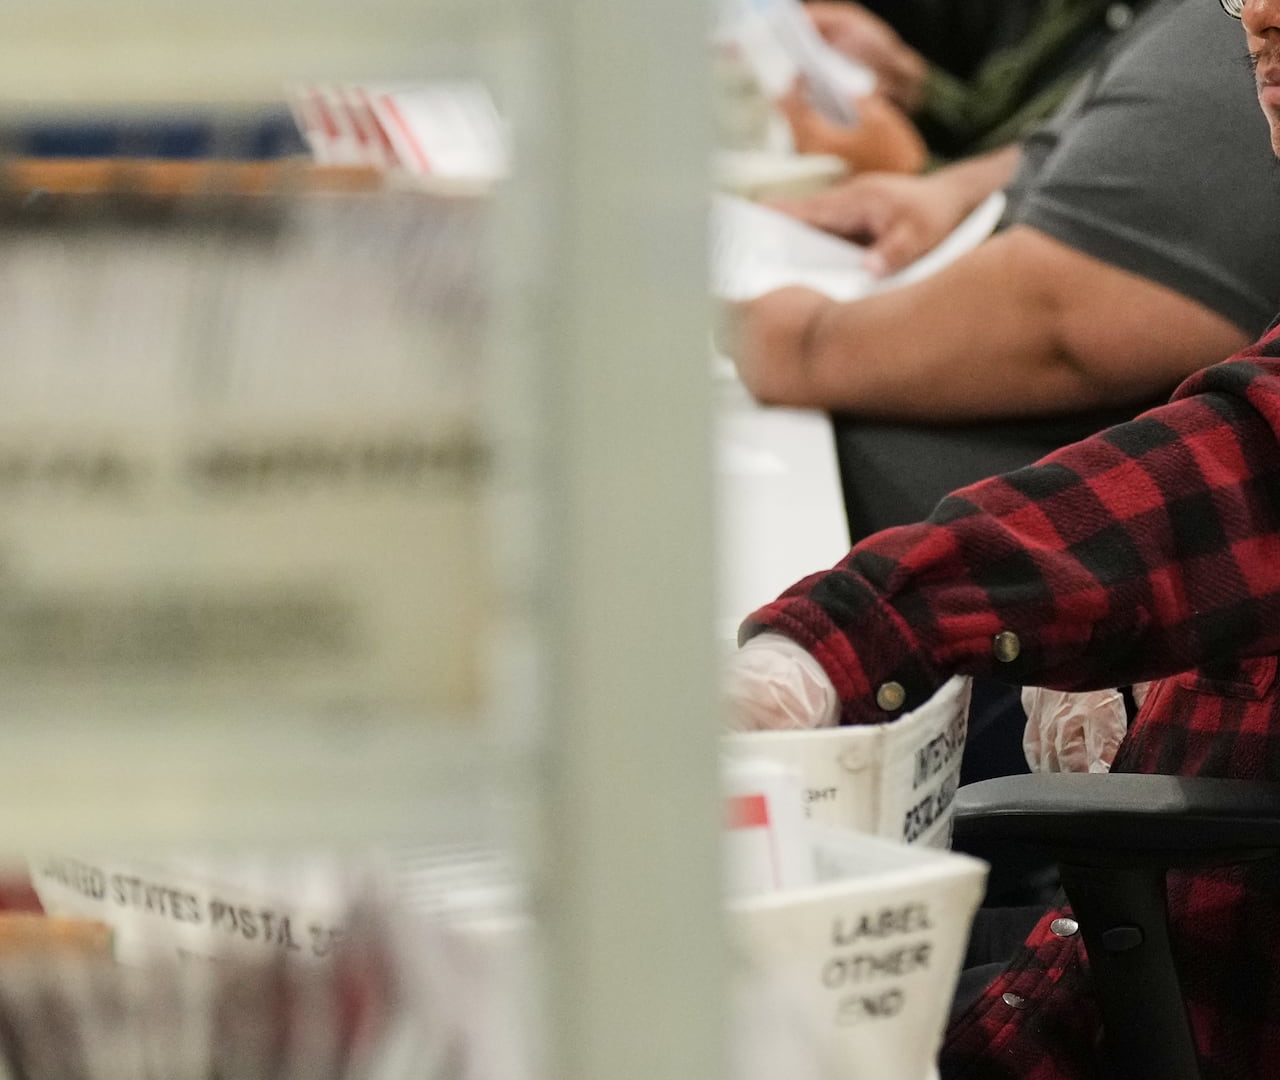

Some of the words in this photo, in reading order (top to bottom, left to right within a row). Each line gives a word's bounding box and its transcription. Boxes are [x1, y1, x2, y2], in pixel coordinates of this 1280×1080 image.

[831, 901, 933, 946] LABEL
[821, 941, 933, 989] OTHER
[836, 987, 905, 1026] END
